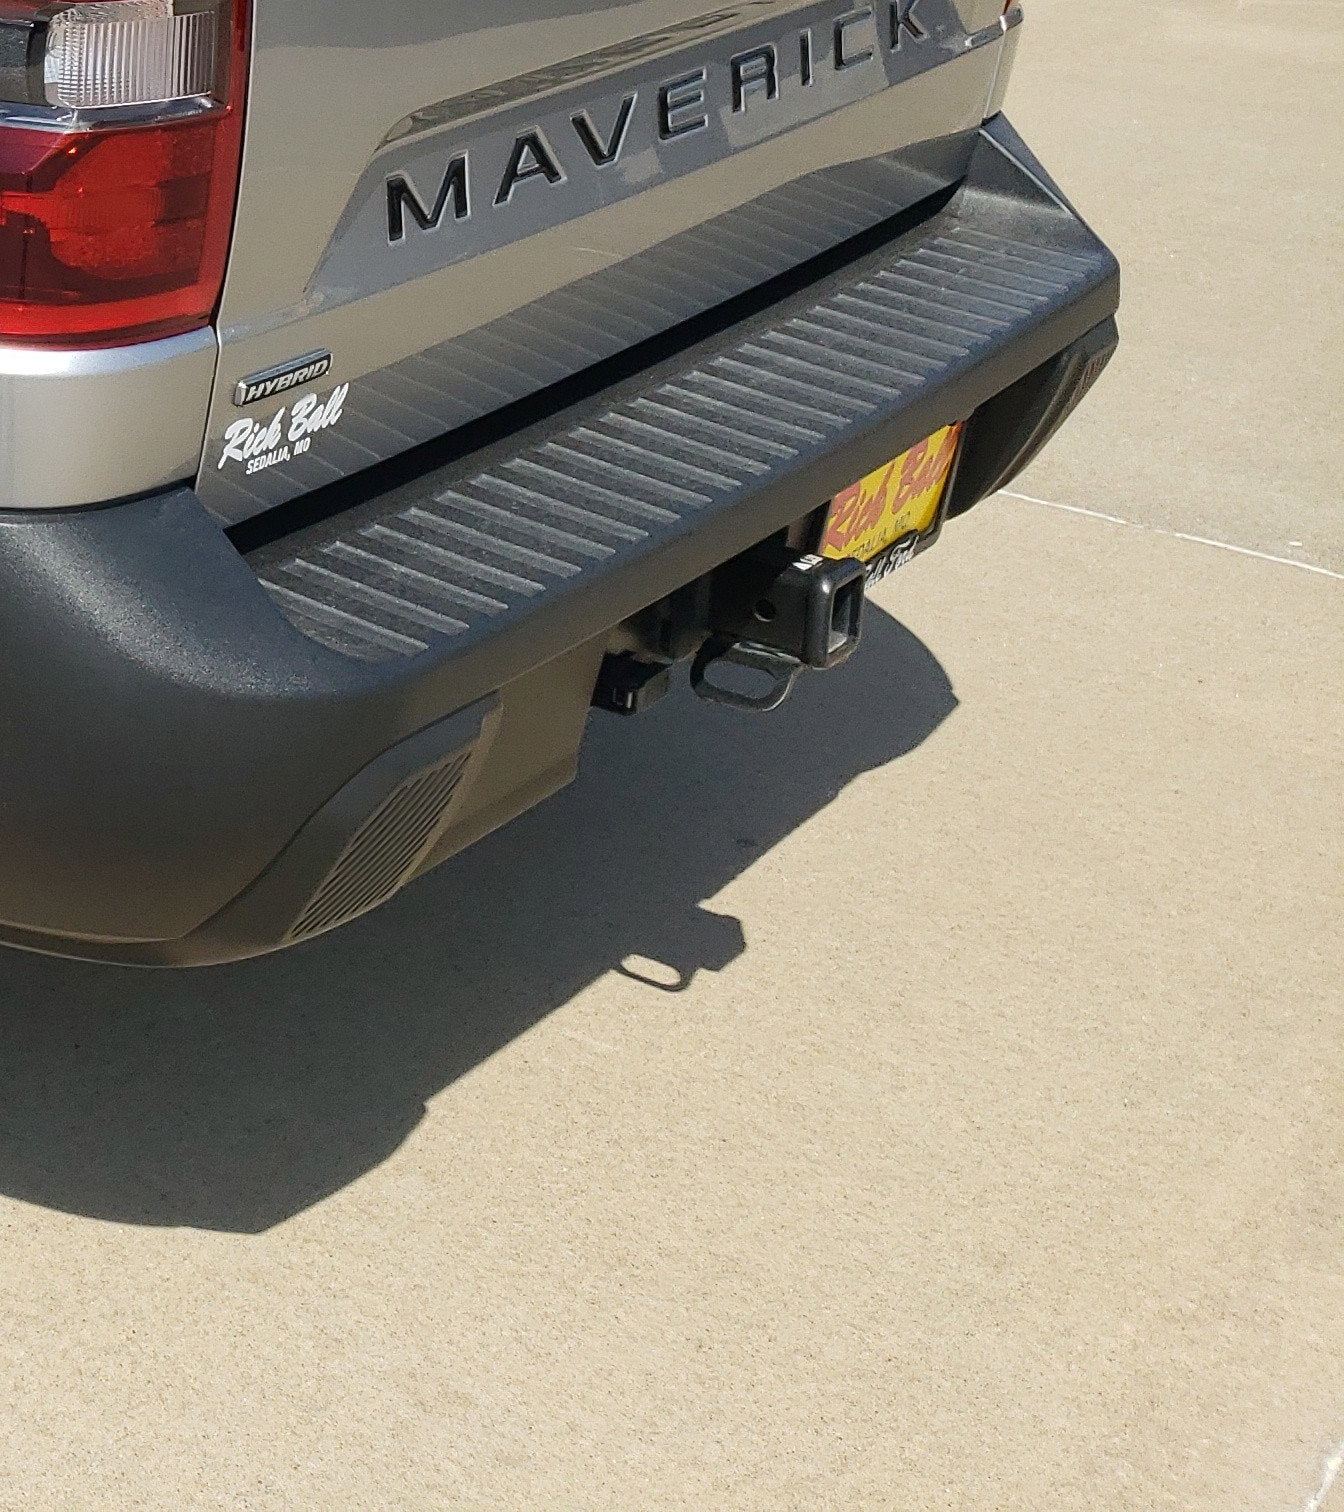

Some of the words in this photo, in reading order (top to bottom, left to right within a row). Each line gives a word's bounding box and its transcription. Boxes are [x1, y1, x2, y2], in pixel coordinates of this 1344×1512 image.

[246, 358, 329, 402] HYBRID
[218, 406, 286, 470] Rick
[288, 382, 350, 443] Ball
[245, 445, 292, 475] SEDALIA,
[293, 437, 311, 457] MO
